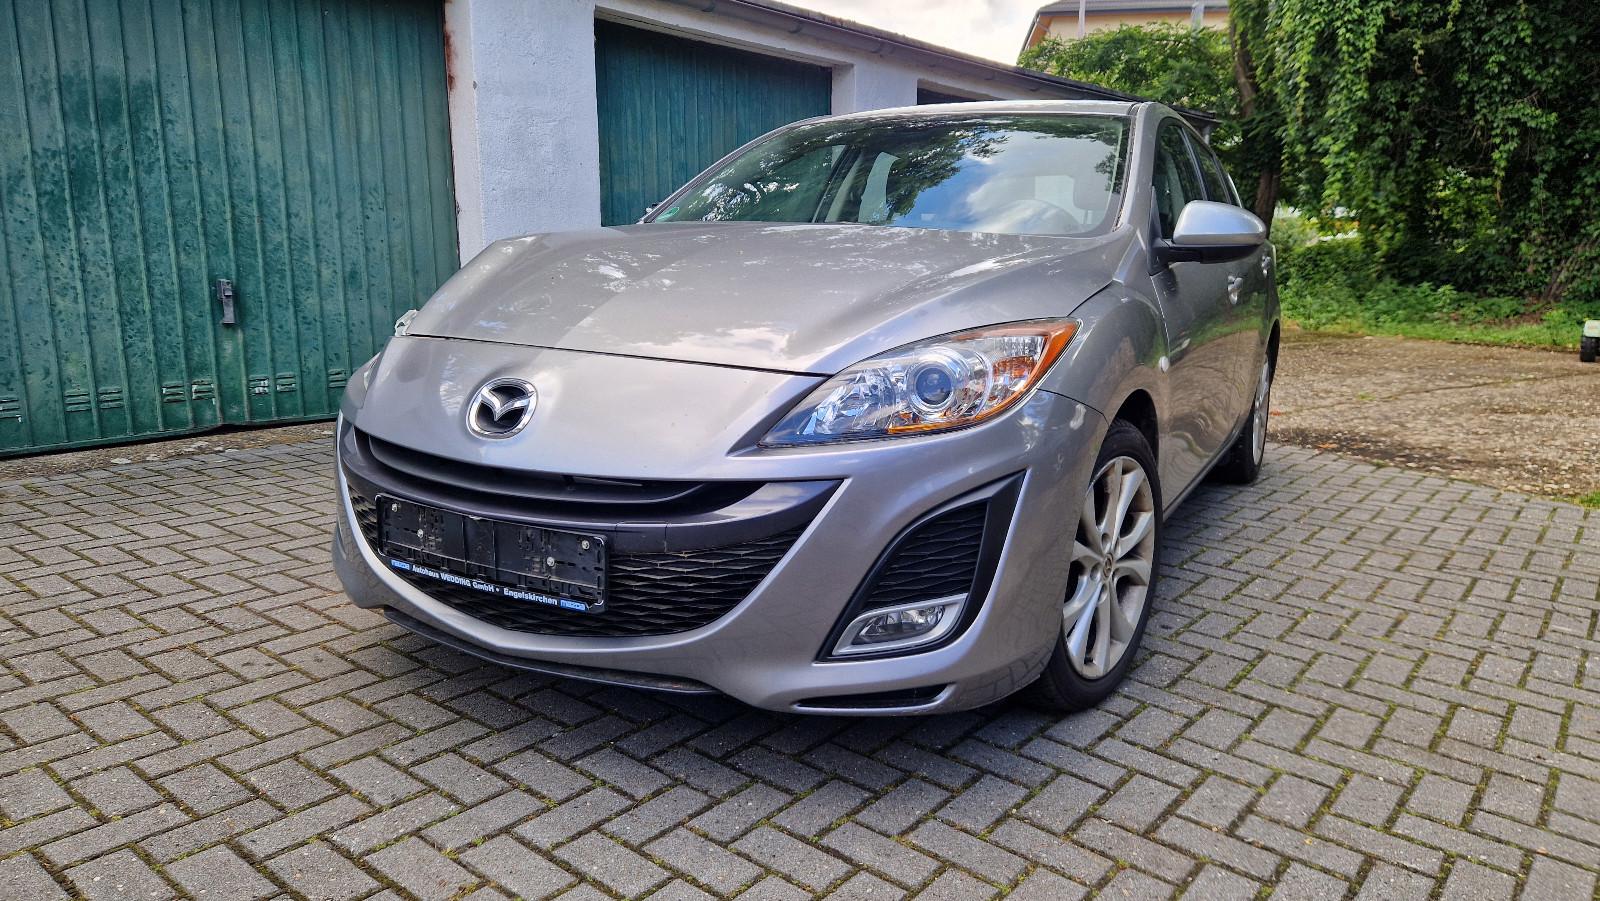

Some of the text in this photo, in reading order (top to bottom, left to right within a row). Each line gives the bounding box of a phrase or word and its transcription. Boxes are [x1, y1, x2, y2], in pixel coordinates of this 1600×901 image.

[412, 565, 440, 579] Autohaus
[440, 572, 472, 587] WEDDING
[473, 581, 495, 593] GmbH
[503, 587, 558, 606] Engelskirchen
[560, 599, 586, 611] mazda
